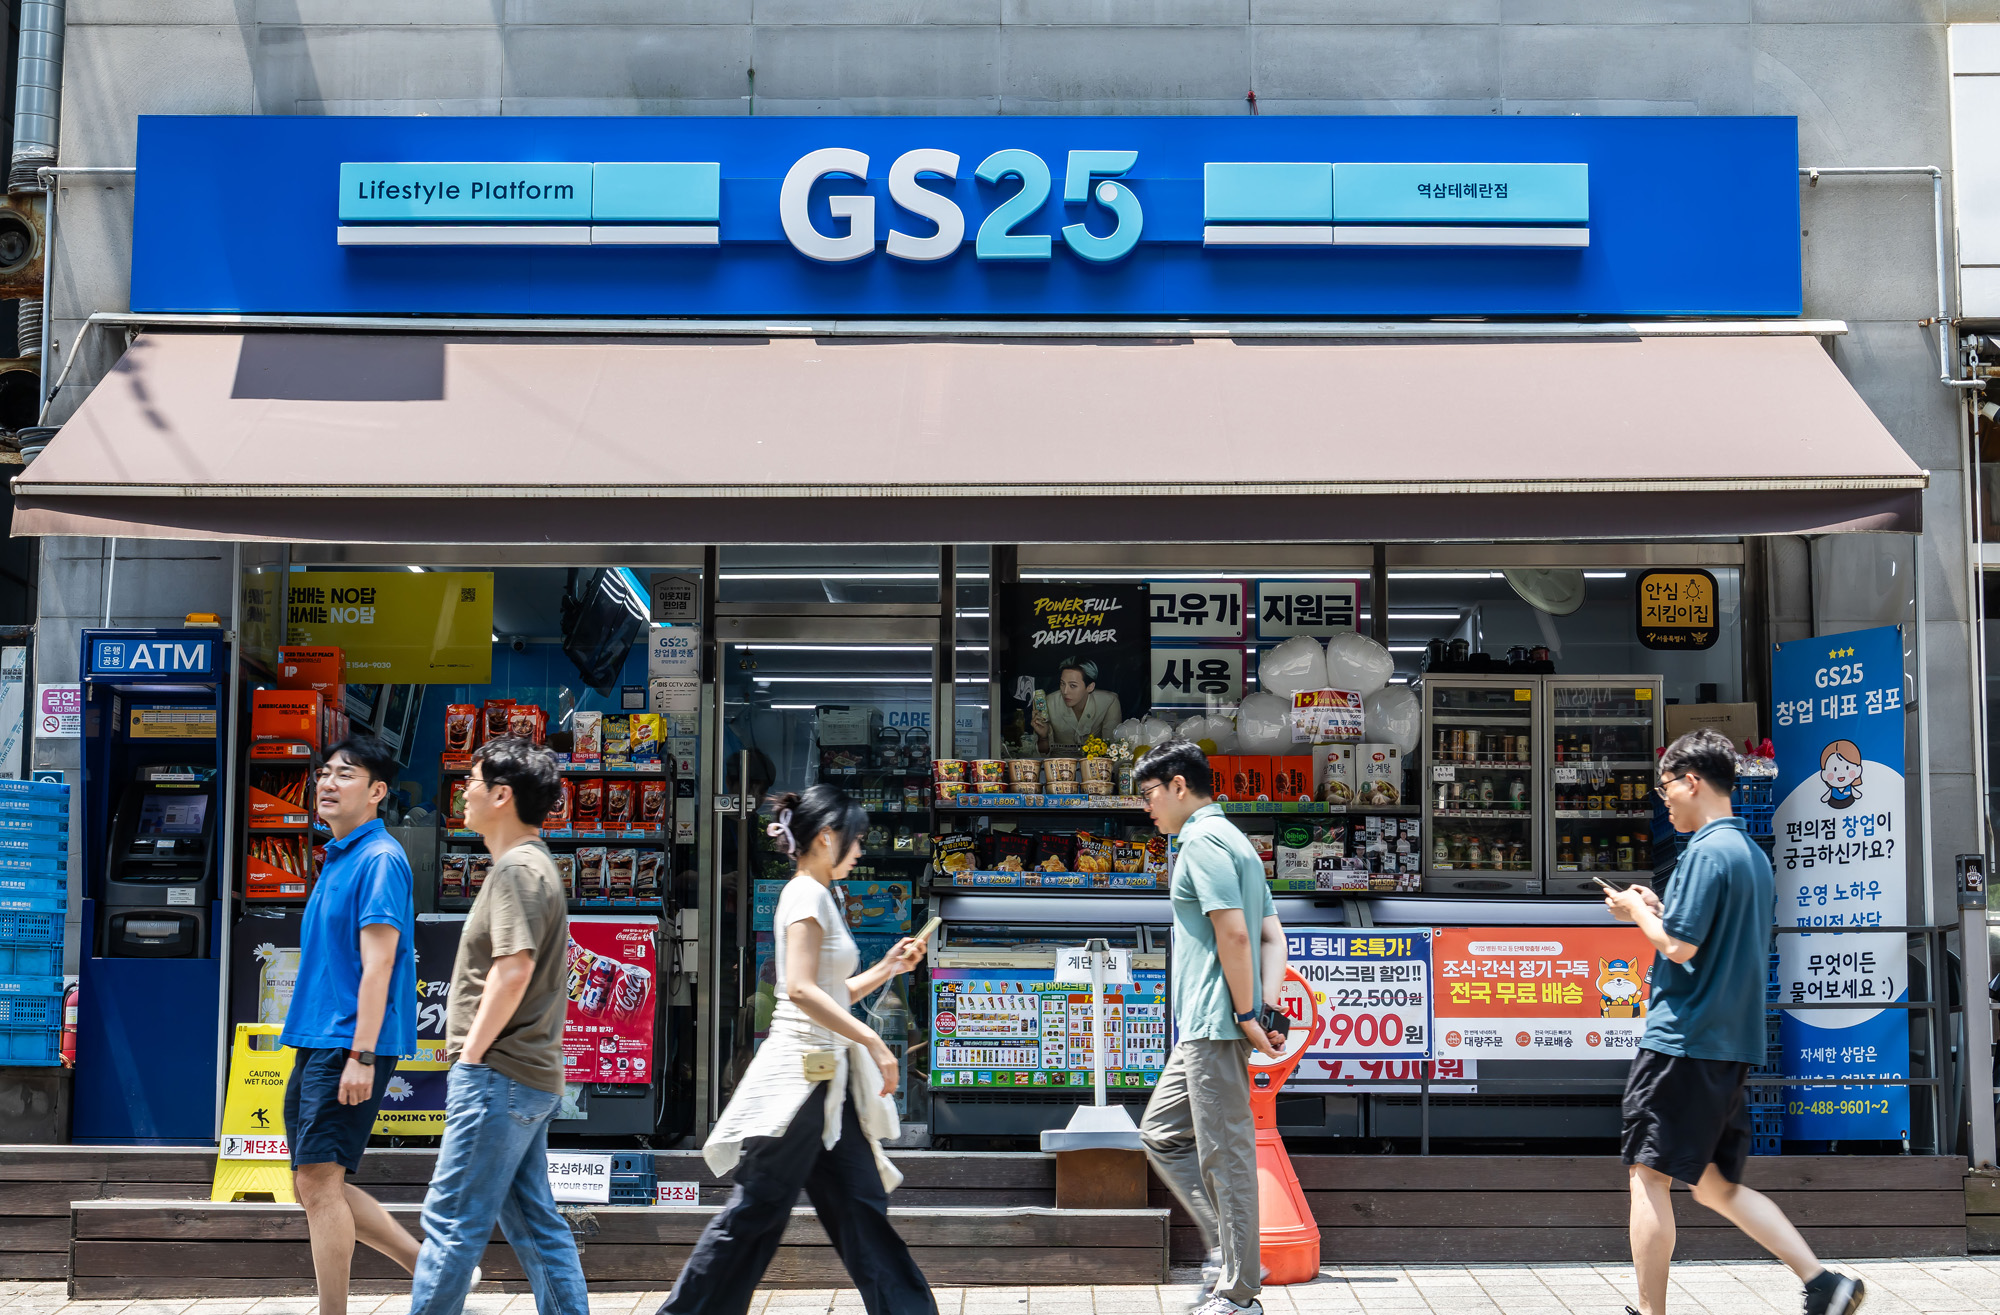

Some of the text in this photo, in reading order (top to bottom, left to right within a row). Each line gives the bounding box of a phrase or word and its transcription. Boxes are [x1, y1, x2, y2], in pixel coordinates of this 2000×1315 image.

[358, 180, 574, 204] Lifestyle Platform
[1417, 183, 1508, 198] 역삼테헤란점
[780, 147, 1144, 262] GS25
[1645, 582, 1677, 601] 안심
[663, 601, 687, 609] 편의점
[1150, 593, 1241, 626] 고유가
[1262, 594, 1354, 626] 지원금
[1646, 604, 1708, 623] 지킴이집
[1046, 613, 1105, 630] 탄산라거
[659, 637, 688, 648] GS25
[1031, 628, 1118, 649] DAISY LAGER
[103, 646, 121, 656] 은행
[128, 643, 205, 670] ATM
[654, 648, 694, 658] 창업플랫폼
[103, 657, 121, 666] 공용
[284, 666, 298, 677] IP
[1157, 658, 1231, 695] 사용
[1814, 662, 1864, 689] GS25
[1776, 687, 1901, 726] 창업 대표 점포
[889, 711, 931, 727] CARE
[955, 719, 973, 728] 식품
[603, 724, 629, 733] MAGIC
[1323, 763, 1345, 774] 삼계탕
[1366, 763, 1390, 774] 삼계탕
[1225, 802, 1252, 812] 덤증정
[1256, 802, 1283, 812] 덤증정
[1297, 803, 1324, 813] 덤증정
[1786, 811, 1891, 843] 편의점 창업이
[1001, 836, 1028, 845] NETFLIX
[1042, 835, 1069, 845] NETFLIX
[1783, 838, 1895, 870] 궁금하신가요?
[1317, 859, 1334, 869] 1+1
[1288, 880, 1316, 890] 덤증정
[1796, 880, 1882, 907] 운영 노하우
[756, 904, 771, 914] GS
[1288, 937, 1412, 957] 리 동네 초특가!
[1067, 955, 1118, 970] 계단심
[1518, 960, 1552, 978] 정기
[1555, 960, 1590, 978] 구독
[1807, 951, 1876, 976] 무엇이든
[1300, 965, 1422, 982] 아이스크림 할인!!
[1030, 982, 1045, 992] 7월
[1280, 985, 1289, 993] 다
[1449, 982, 1584, 1004] 전국 무료 배송
[1790, 978, 1876, 1004] 물어보세요
[1280, 997, 1303, 1021] 지
[1464, 1036, 1504, 1047] 대량주문
[1534, 1036, 1574, 1047] 무료배송
[1800, 1046, 1878, 1064] 자세한 상담은
[249, 1070, 281, 1078] CAUTION
[244, 1078, 284, 1086] WET FLOOR
[1788, 1099, 1889, 1115] 02-488-9601~2
[377, 1113, 427, 1122] LOOMING
[548, 1162, 605, 1176] 조심하세요
[558, 1182, 581, 1190] YOUR
[582, 1183, 604, 1191] STEP
